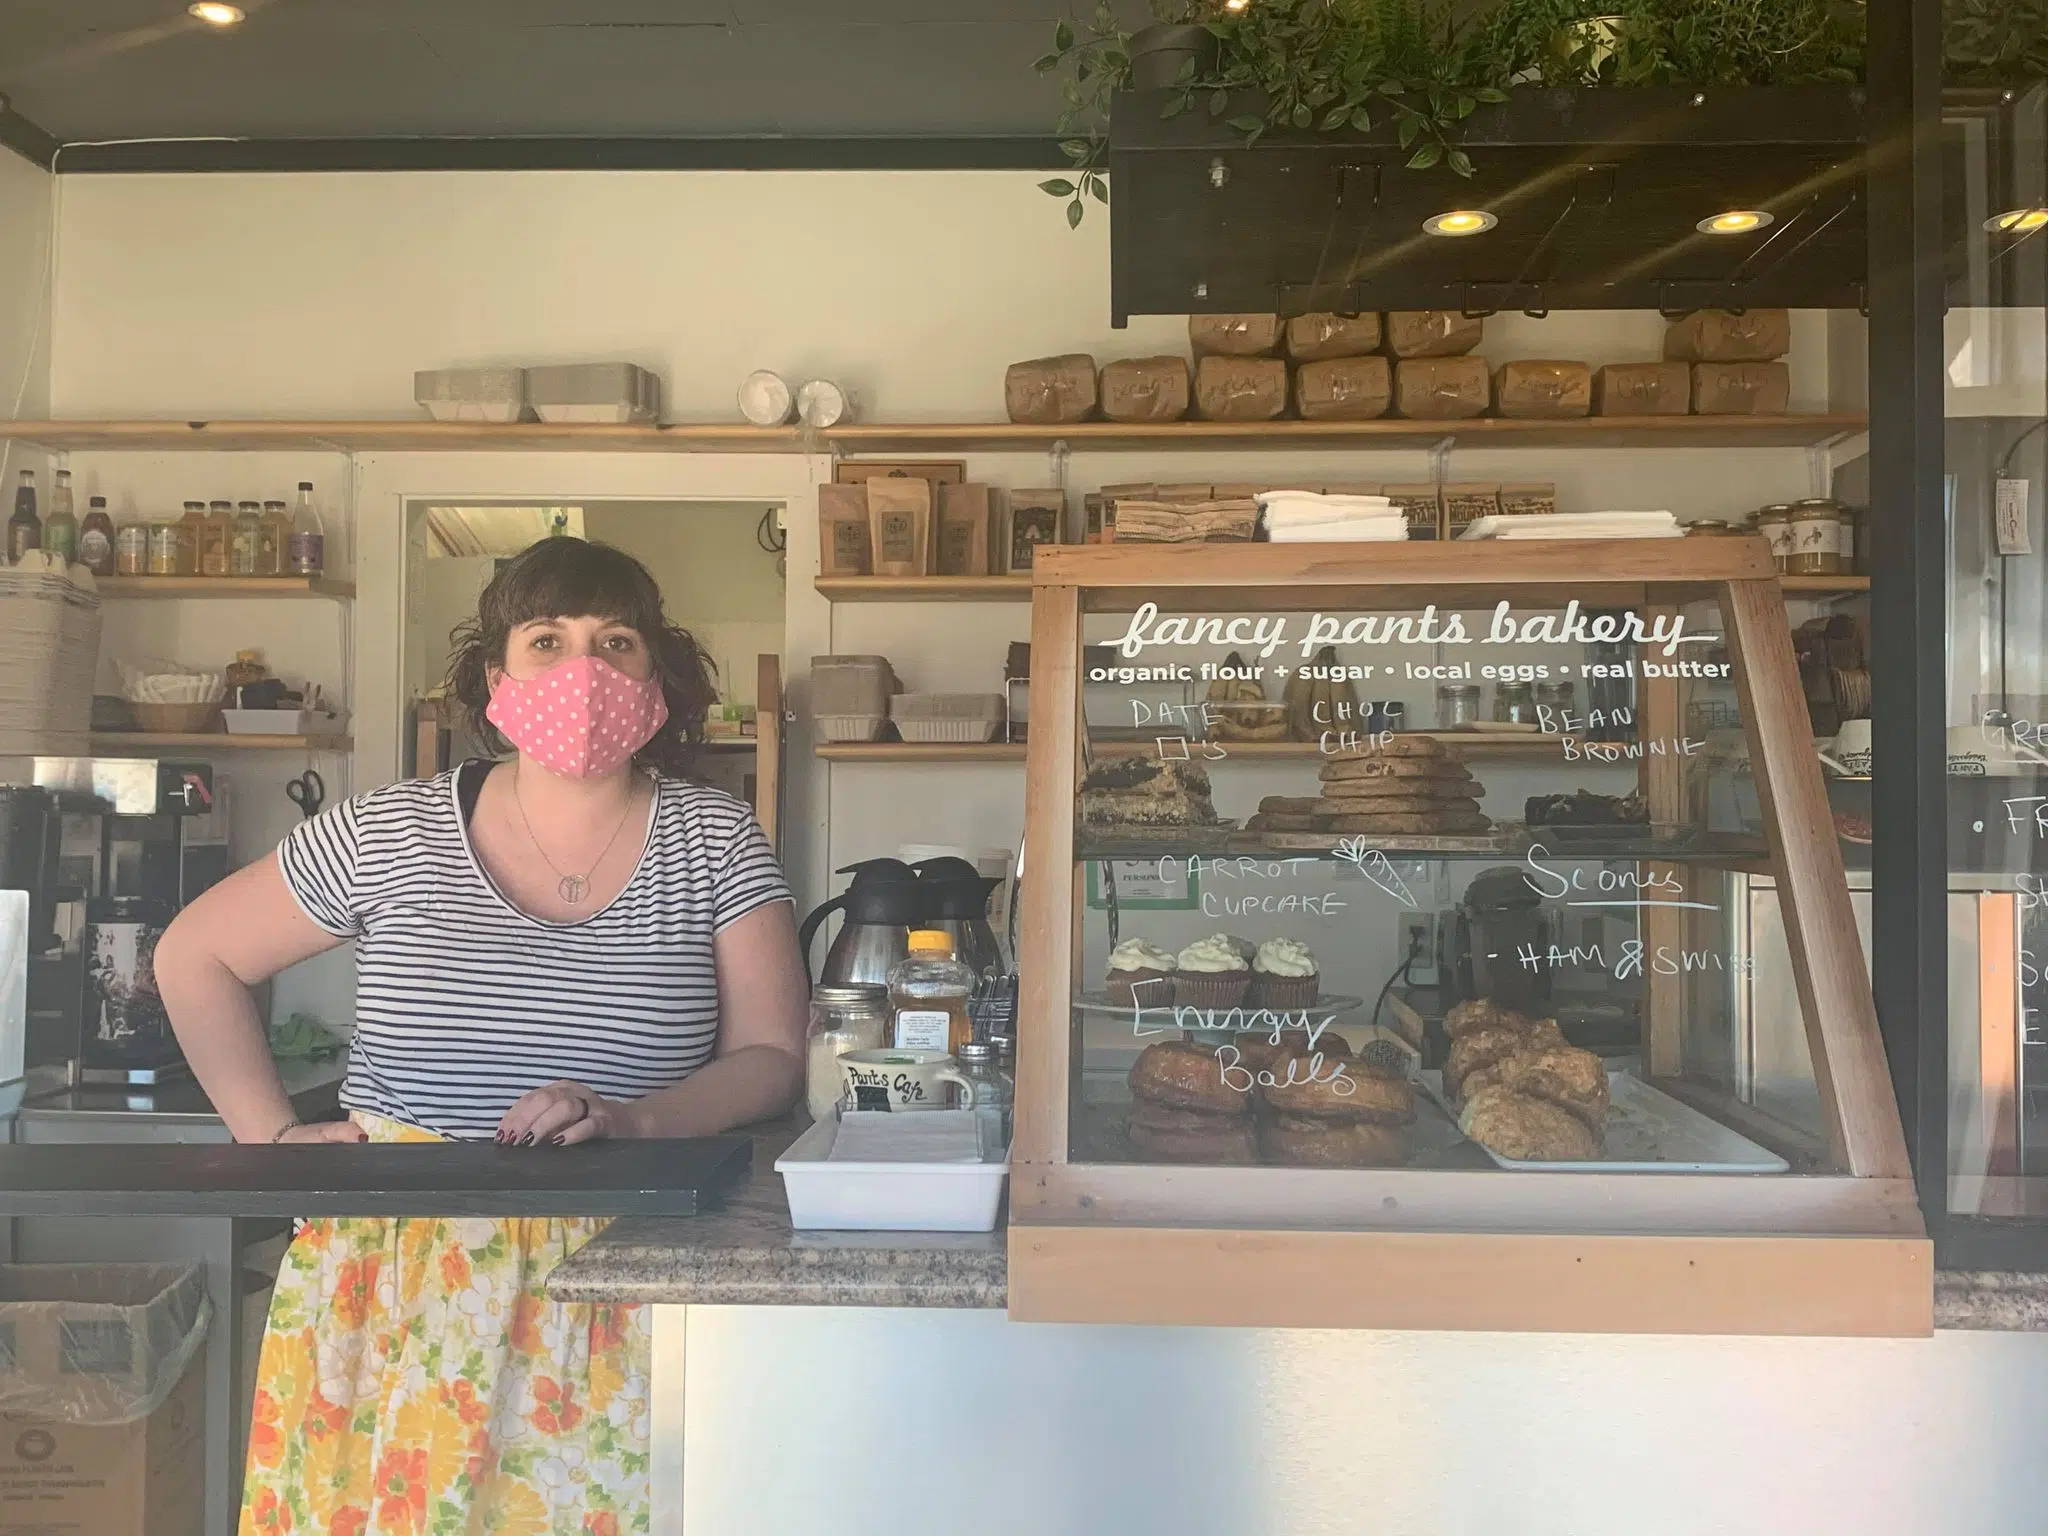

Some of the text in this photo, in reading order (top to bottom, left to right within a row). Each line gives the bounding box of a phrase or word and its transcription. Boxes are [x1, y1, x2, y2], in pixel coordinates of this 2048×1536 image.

[1098, 600, 1719, 658] fancy pants bakery
[1090, 663, 1193, 684] organic
[1200, 662, 1264, 681] flour
[1299, 664, 1374, 684] sugar
[1406, 662, 1471, 680] local
[1481, 664, 1549, 683] eggs
[1581, 661, 1633, 679] real
[1643, 661, 1731, 679] butter
[1129, 699, 1223, 728] DATE
[1312, 700, 1405, 724] CHOC
[1536, 704, 1632, 734] BEAN
[1319, 730, 1395, 756] CHIP
[1563, 737, 1706, 763] BROWNIE
[1158, 854, 1320, 884] CARROT
[1522, 843, 1684, 900] Scones
[1202, 892, 1347, 917] CUPCAKE
[1517, 942, 1606, 974] HAM
[1130, 977, 1337, 1051] Energy
[1214, 1045, 1357, 1096] Balls
